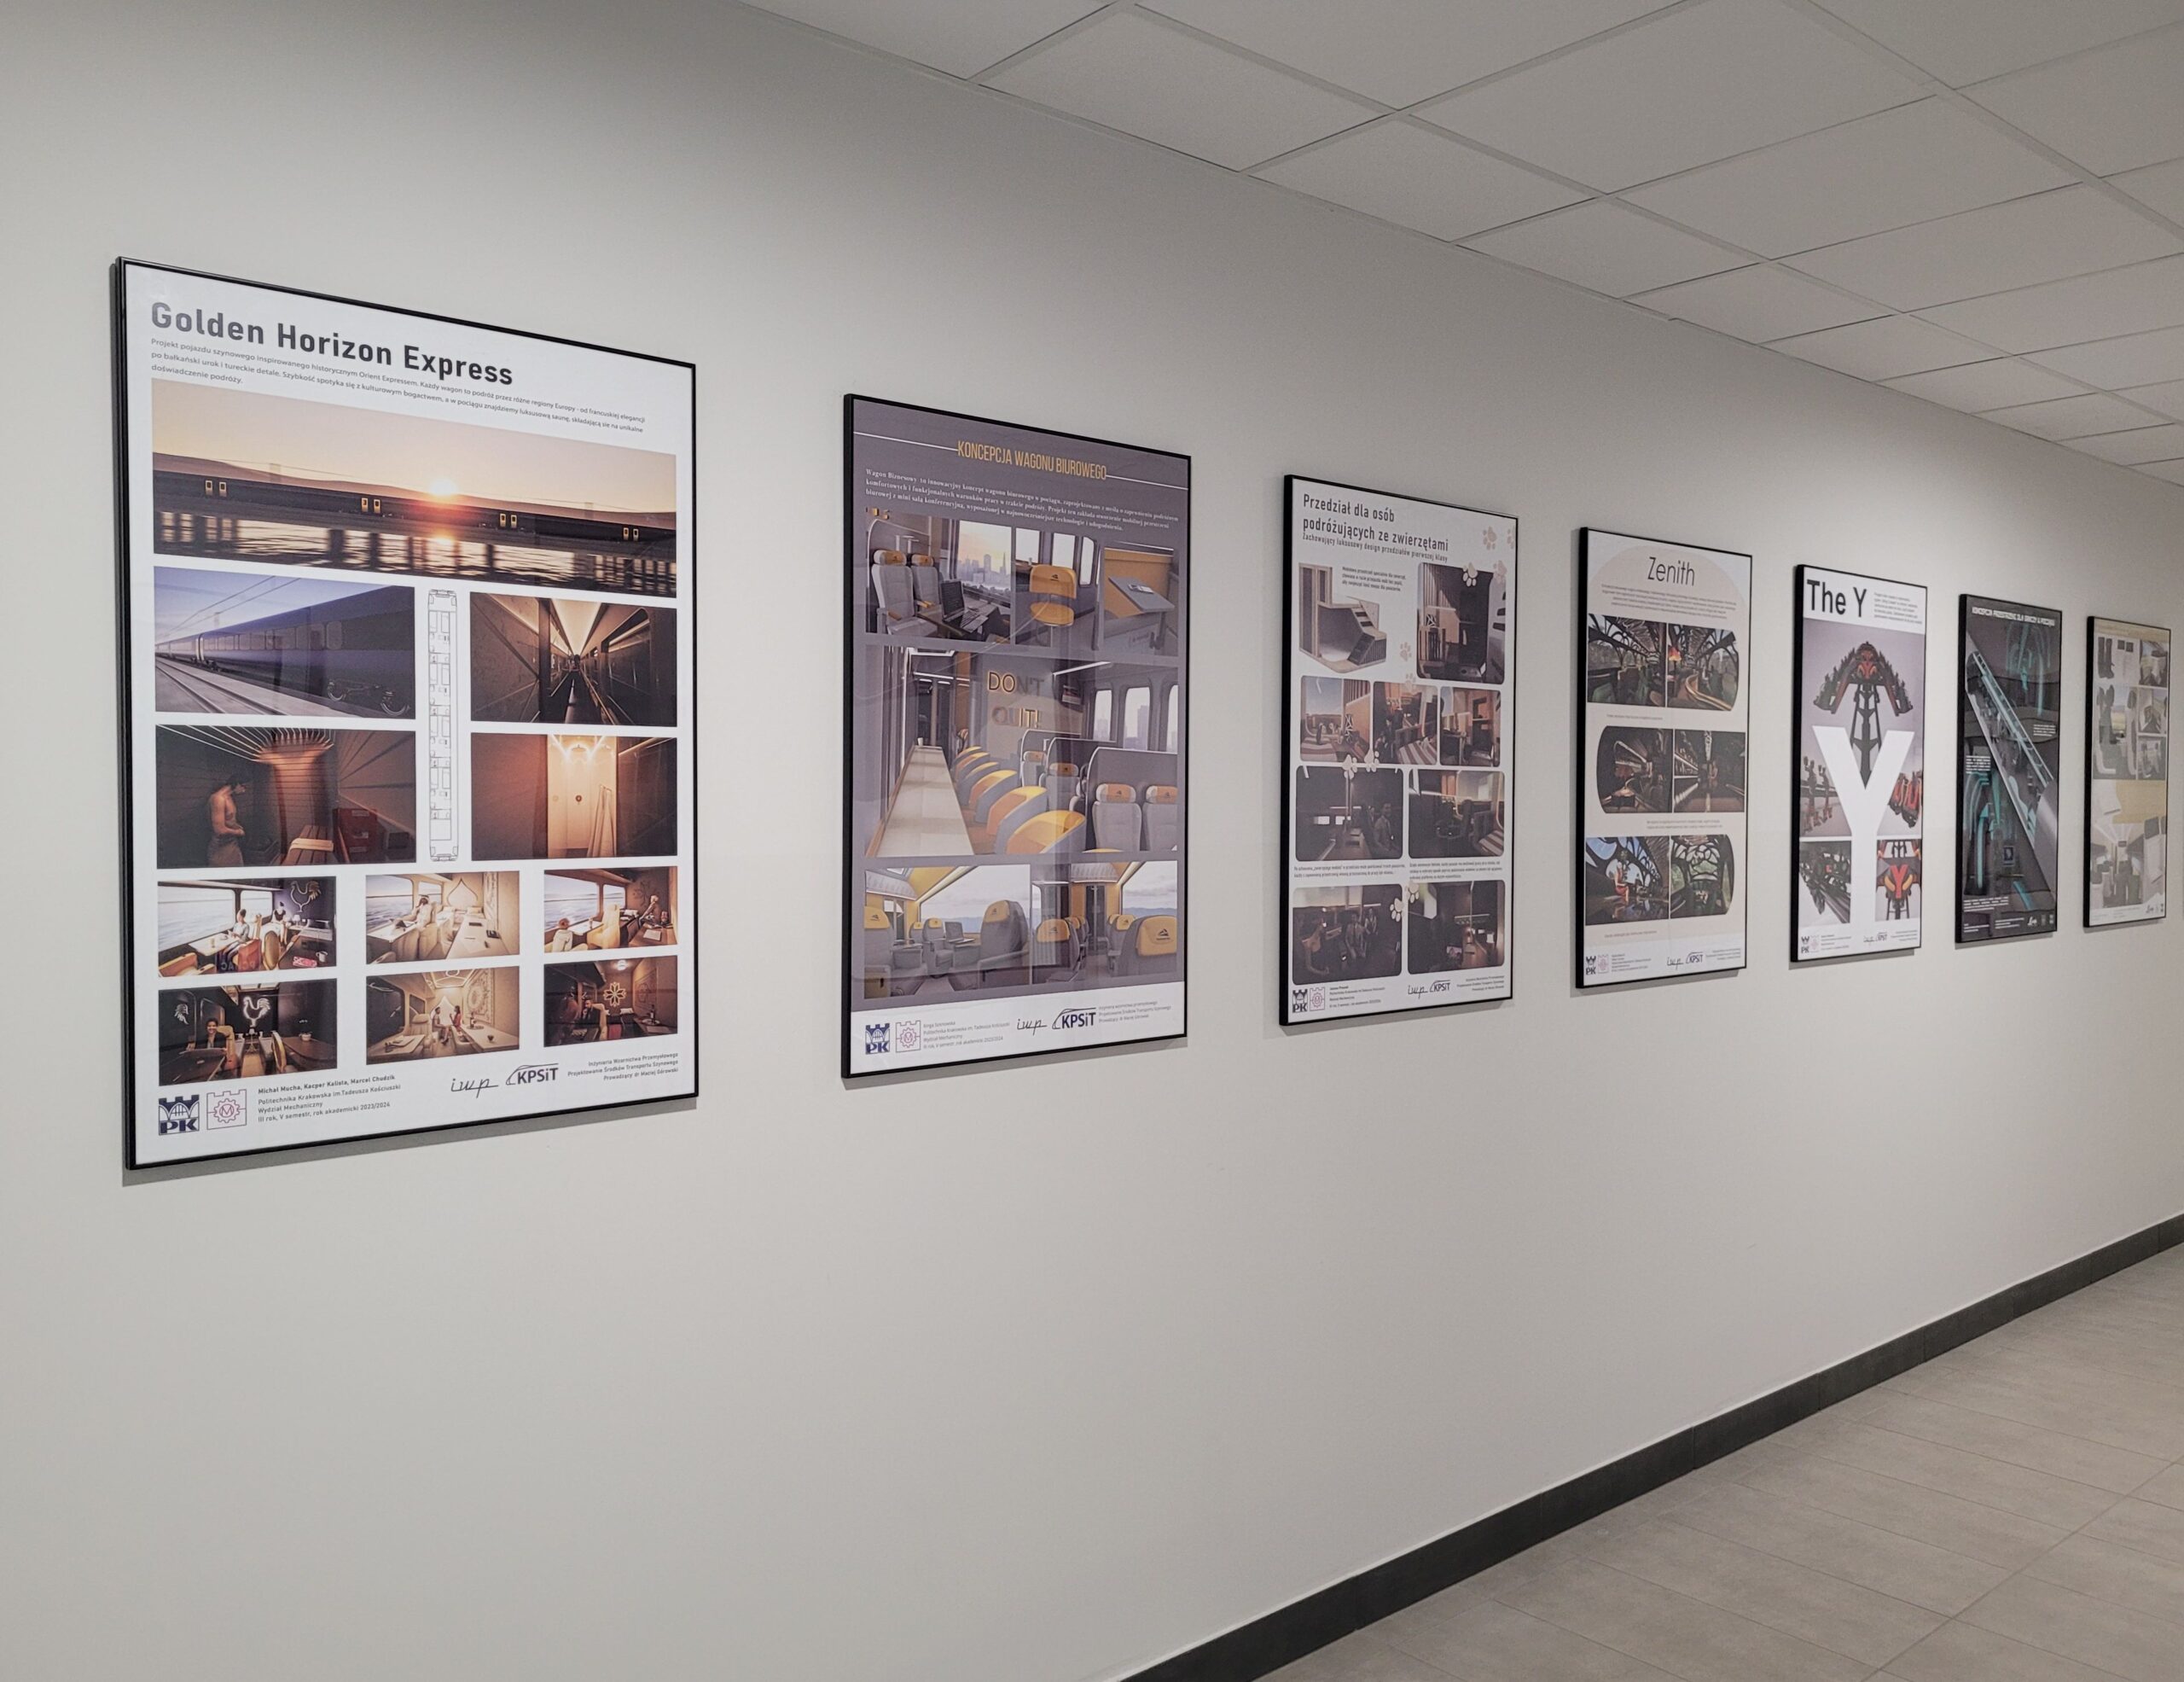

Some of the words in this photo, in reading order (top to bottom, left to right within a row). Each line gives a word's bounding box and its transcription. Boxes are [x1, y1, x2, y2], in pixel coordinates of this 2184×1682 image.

[151, 301, 264, 344] Golden
[277, 323, 392, 365] Horizon
[404, 345, 513, 385] Express
[150, 336, 178, 348] Projekt
[179, 342, 212, 353] pojazdu
[212, 348, 255, 362] szynowego
[256, 353, 310, 371] inspirowanego
[311, 363, 357, 378] historycznym
[358, 370, 380, 381] Orient
[381, 374, 418, 387] Expressem.
[440, 385, 462, 394] wagon
[463, 387, 471, 395] to
[494, 393, 513, 402] przez
[513, 395, 530, 404] różne
[531, 399, 553, 410] regiony
[555, 401, 575, 414] Europy
[579, 405, 588, 414] od
[588, 406, 619, 421] francuskiej
[619, 412, 645, 425] elegancji
[151, 363, 209, 378] doświadczenie
[209, 373, 244, 386] podróży.
[151, 352, 162, 360] po
[163, 352, 200, 364] bałkański
[224, 361, 254, 373] tureckie
[256, 365, 280, 376] detale.
[282, 370, 315, 381] Szybkość
[316, 376, 344, 387] spotyka
[345, 380, 355, 390] się
[361, 381, 402, 397] kulturowym
[403, 388, 444, 404] bogactwem,
[456, 399, 483, 410] pociągu
[483, 403, 519, 416] znajdziemy
[519, 406, 550, 421] luksusową
[551, 413, 571, 424] saunę,
[619, 422, 643, 433] unikalne
[957, 440, 1013, 465] KONCEPCJA
[1014, 450, 1054, 472] WAGONU
[1055, 457, 1107, 480] BIUROWEGO
[865, 469, 886, 478] Wagon
[887, 472, 916, 484] Biznesowy
[1304, 494, 1351, 515] Przedział
[1354, 503, 1369, 519] dla
[1373, 507, 1395, 522] osób
[1303, 517, 1375, 539] podróżujących
[1379, 529, 1389, 543] ze
[1392, 533, 1449, 551] zwierzętami
[1647, 556, 1695, 586] Zenith
[1807, 579, 1846, 615] The
[1853, 587, 1867, 618] Y
[1062, 1012, 1096, 1029] KPSiT
[866, 1042, 890, 1053] PK
[258, 1085, 278, 1094] Michał
[350, 1076, 370, 1085] Marcel
[517, 1068, 559, 1085] KPSiT
[258, 1095, 296, 1105] Politechnika
[298, 1091, 331, 1101] Krakowska
[369, 1083, 401, 1093] Kościuszki
[258, 1105, 282, 1115] Wydział
[283, 1101, 322, 1111] Mechaniczny
[285, 1110, 311, 1119] semestr,
[324, 1104, 358, 1115] akademicki
[360, 1100, 390, 1110] 2023/2024
[160, 1120, 198, 1134] PK
